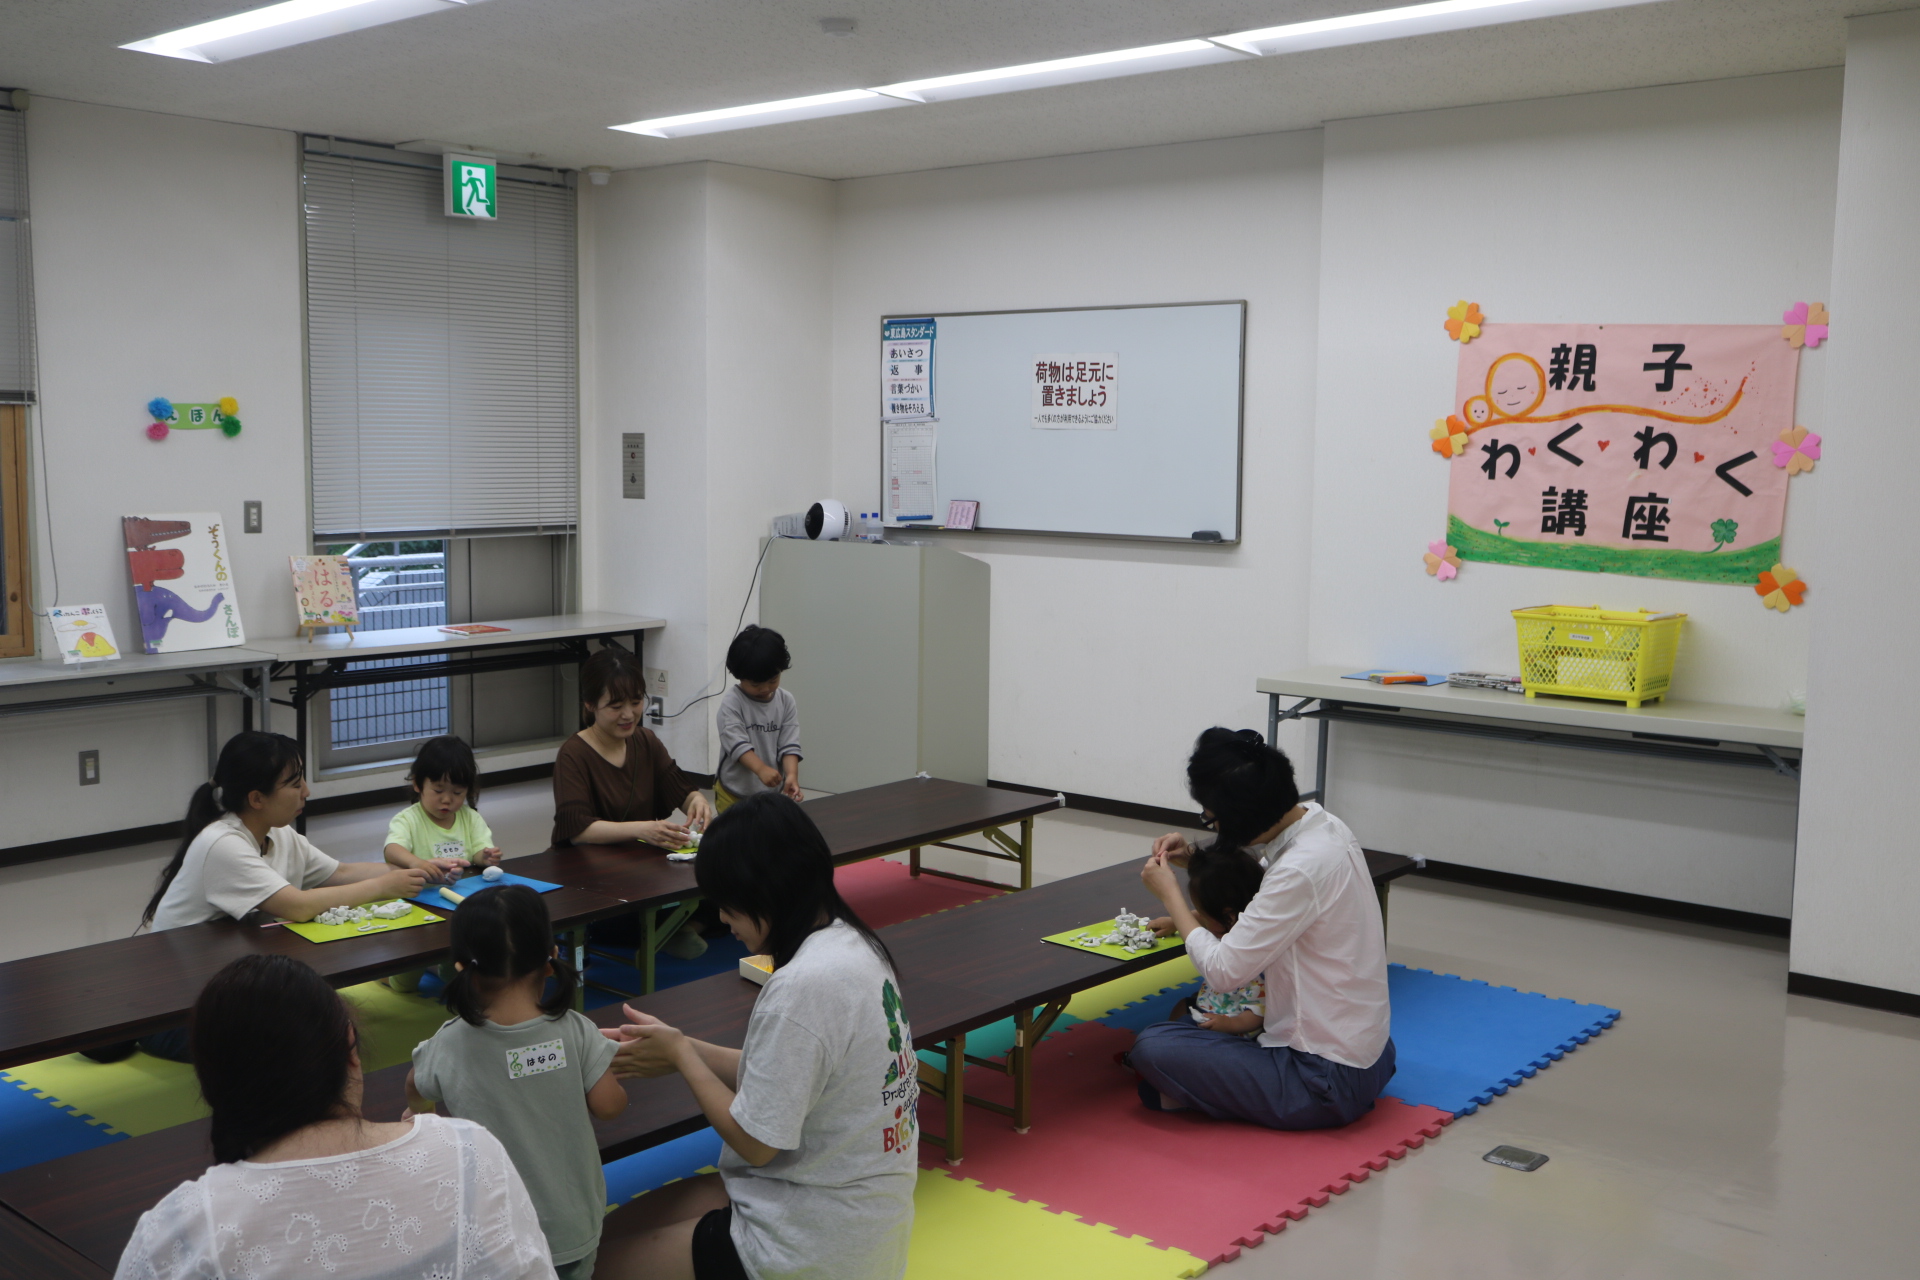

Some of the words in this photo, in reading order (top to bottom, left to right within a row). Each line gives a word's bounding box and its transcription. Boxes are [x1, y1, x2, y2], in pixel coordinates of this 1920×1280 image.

[890, 326, 933, 339] 東広島スタンダード
[890, 347, 924, 359] あいさつ
[890, 364, 923, 376] 返事
[1035, 361, 1113, 383] 荷物は足元に
[890, 383, 923, 395] 言葉づかい
[1042, 385, 1106, 407] 置きましょう
[891, 403, 924, 414] 履き物をそろえる
[207, 523, 228, 582] ぞうくんの
[222, 603, 240, 639] さんぽ
[313, 568, 334, 608] はる
[526, 1053, 557, 1067] はなの
